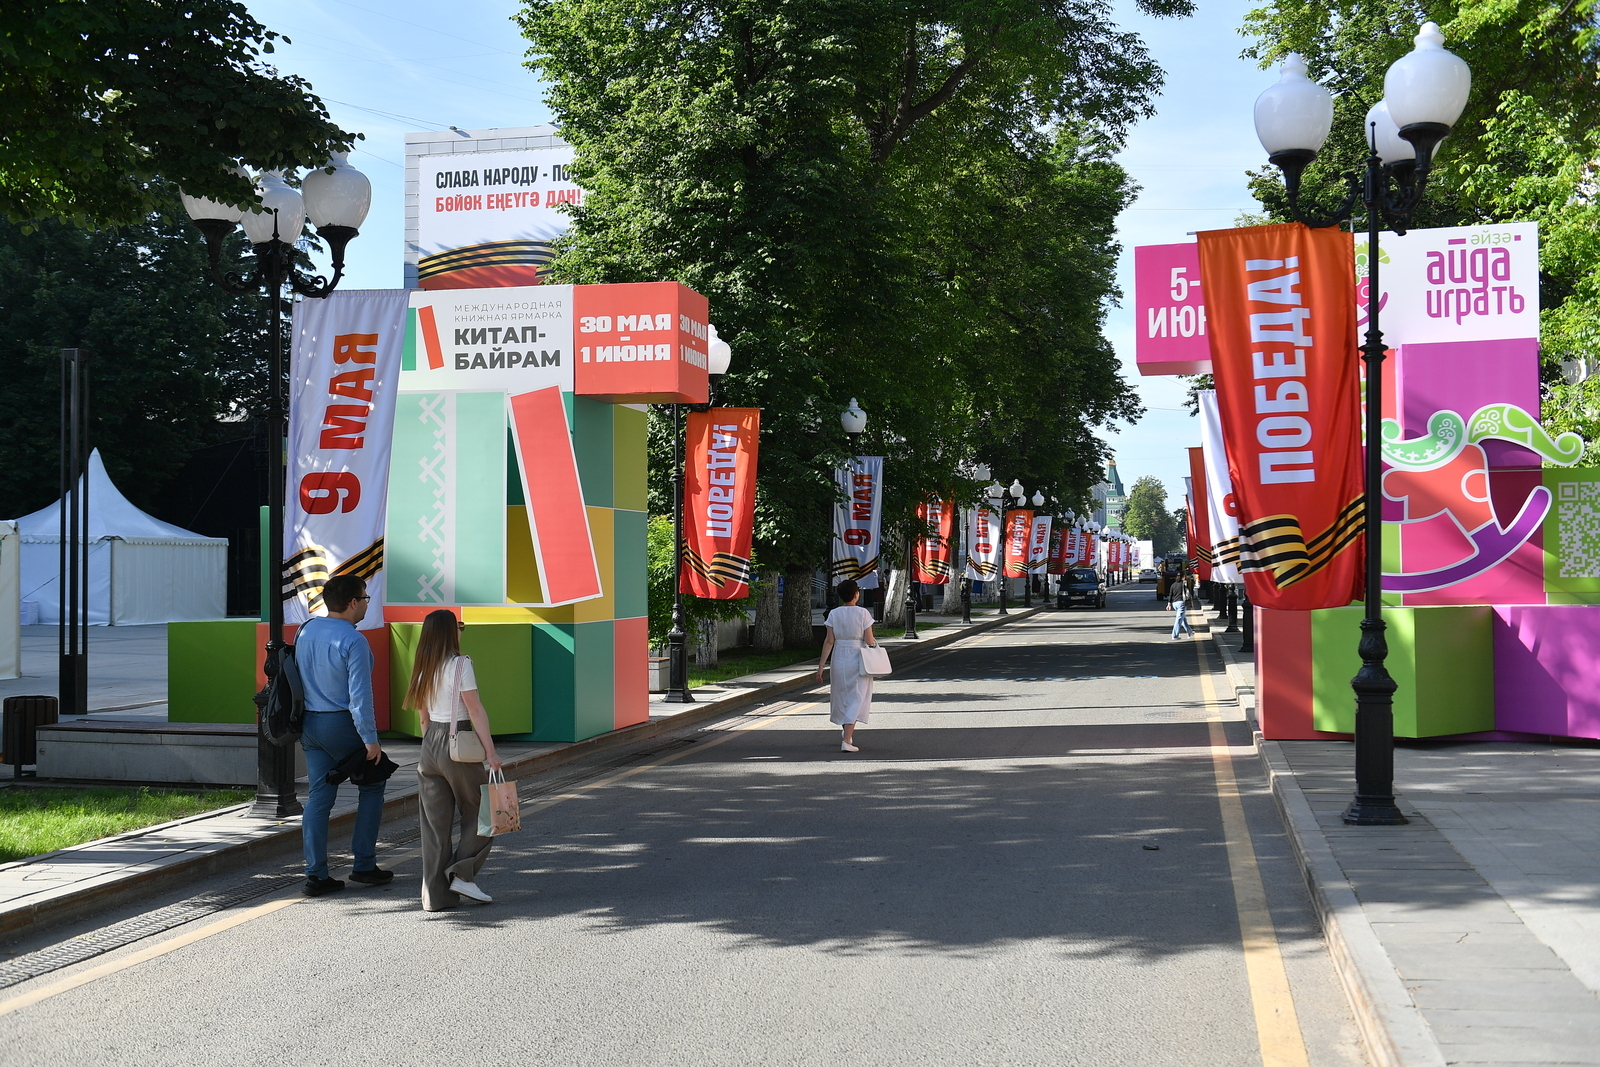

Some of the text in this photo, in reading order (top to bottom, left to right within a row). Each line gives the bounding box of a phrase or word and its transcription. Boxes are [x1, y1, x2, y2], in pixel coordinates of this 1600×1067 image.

[436, 169, 480, 189] СЛАВА
[483, 165, 538, 187] НАРОДУ
[435, 193, 482, 213] БӨЙӨК
[545, 188, 581, 209] ДАН!
[1426, 238, 1511, 290] айда
[454, 300, 562, 313] МЕЖДУНАРОДНАЯ
[454, 311, 563, 323] КНИЖНАЯ ЯРМАРКА
[1426, 285, 1525, 326] играть
[454, 325, 546, 346] КИТАП-
[579, 313, 672, 333] 30 МАЯ
[680, 314, 707, 342] 30 МАЯ
[454, 347, 561, 370] БАЙРАМ
[580, 343, 671, 363] 1 ИЮНЯ
[680, 344, 707, 370] 1 ИЮНЯ
[1245, 255, 1317, 485] ПОБЕДА!
[298, 332, 379, 515] 9 МАЯ
[843, 474, 873, 546] 9 МАЯ
[1032, 523, 1047, 555] 9 МАЯ
[1067, 533, 1077, 551] МАЯ
[1078, 535, 1088, 561] ПОБЕДА!
